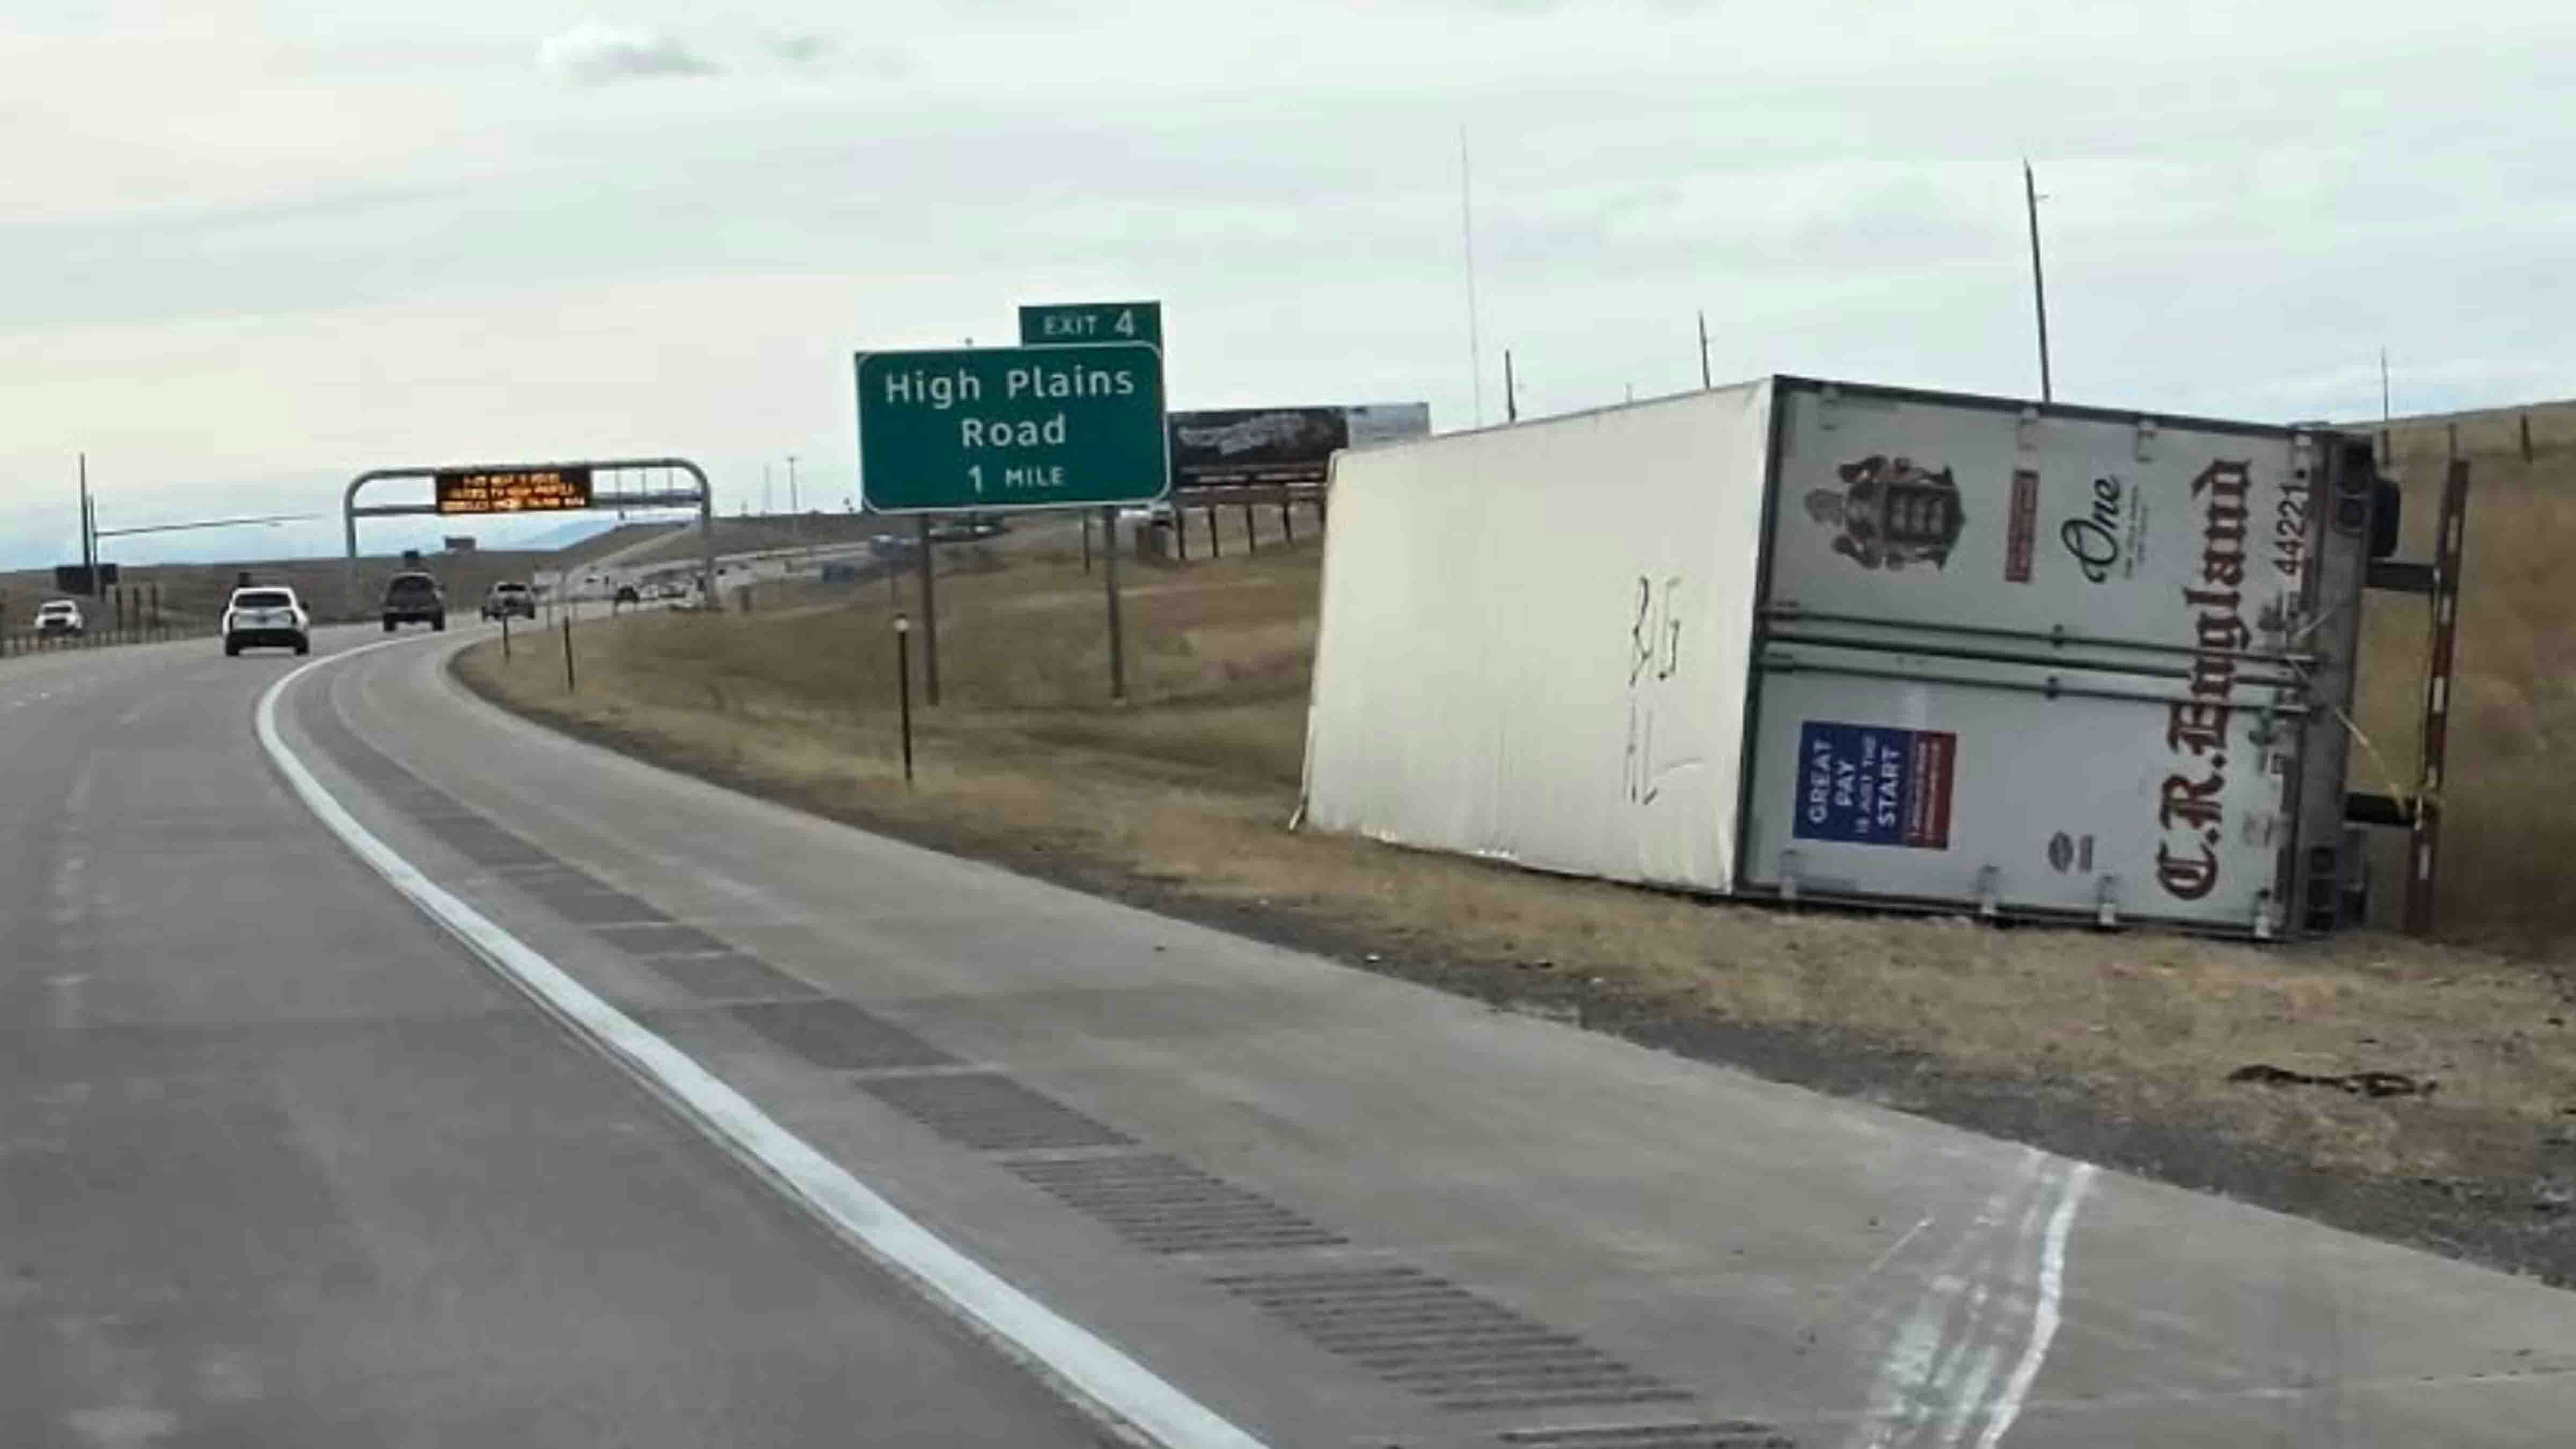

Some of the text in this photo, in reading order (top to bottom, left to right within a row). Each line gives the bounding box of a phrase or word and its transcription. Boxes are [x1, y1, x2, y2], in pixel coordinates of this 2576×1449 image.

[1044, 310, 1135, 336] EXIT 4
[885, 364, 1135, 409] High Plains
[961, 413, 1066, 448] Road
[968, 465, 1065, 493] 1 MILE
[2060, 474, 2121, 584] One
[2271, 482, 2311, 577] 44221
[1808, 739, 1833, 824] GREAT
[1834, 759, 1855, 807] PAY
[1877, 744, 1900, 826] START
